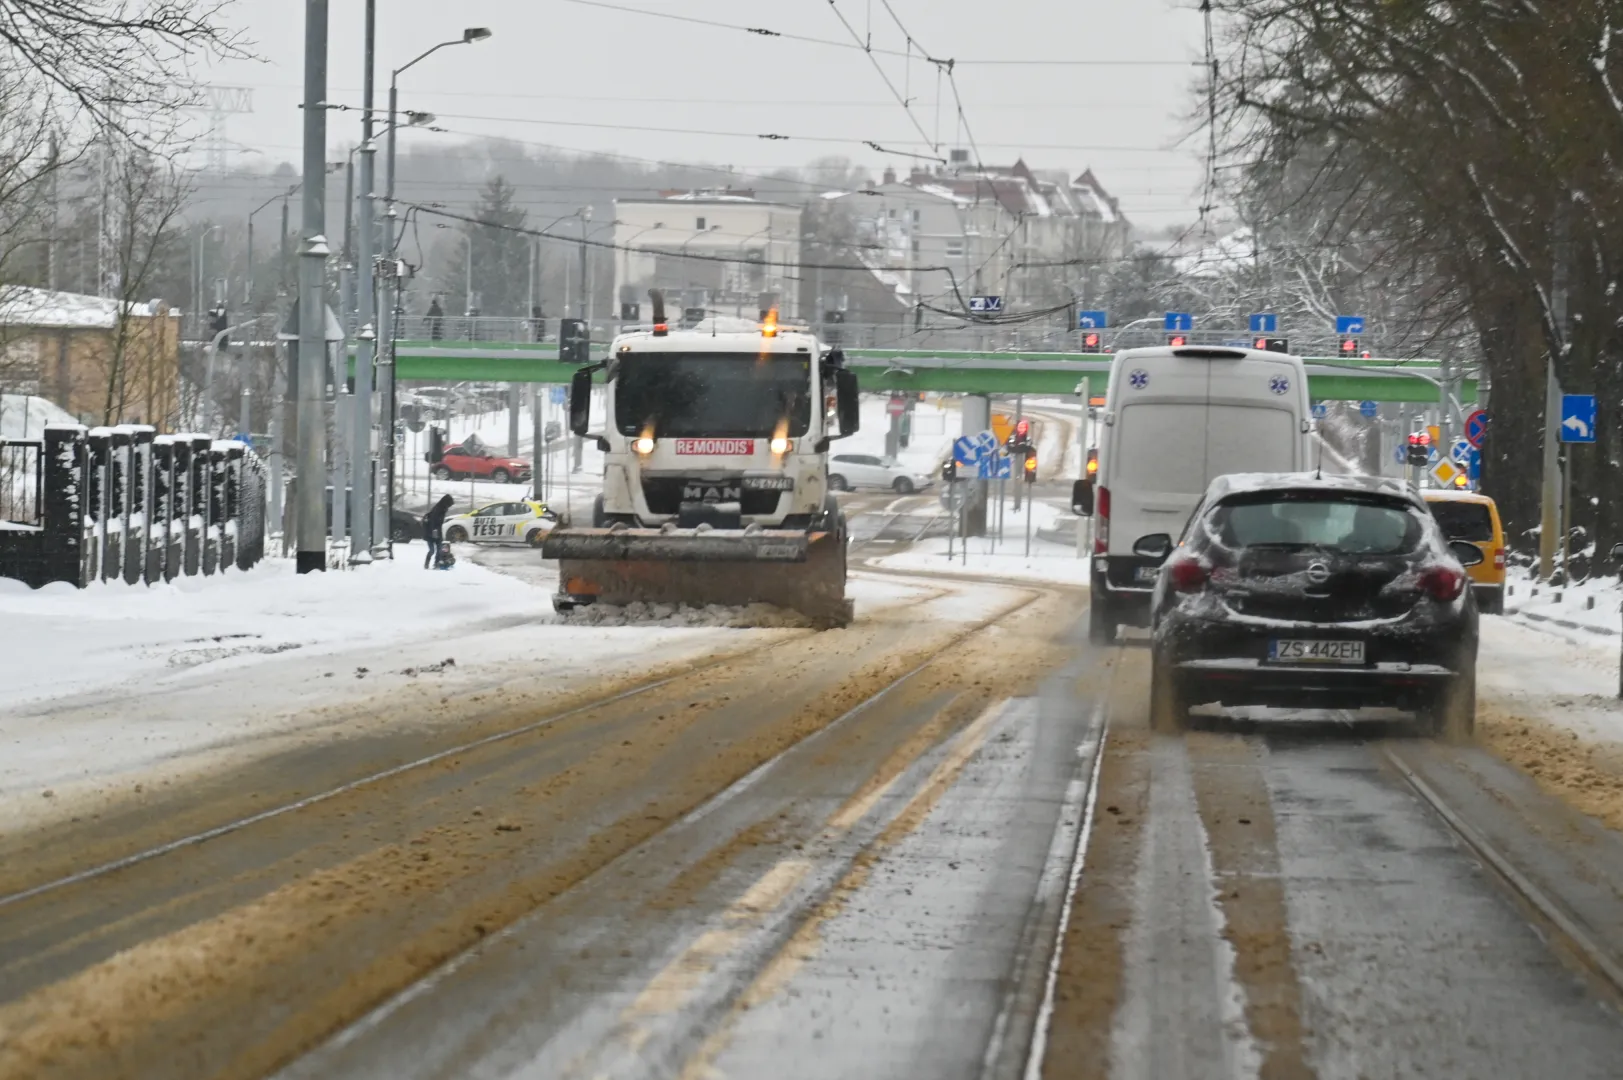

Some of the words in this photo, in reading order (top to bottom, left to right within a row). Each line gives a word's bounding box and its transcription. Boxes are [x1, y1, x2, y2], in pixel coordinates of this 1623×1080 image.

[677, 440, 748, 454] REMONDIS
[683, 487, 740, 499] MAN
[474, 517, 496, 525] AUTO
[473, 524, 504, 536] TEST
[1280, 641, 1304, 658] ZS
[1310, 641, 1361, 659] 442EH
